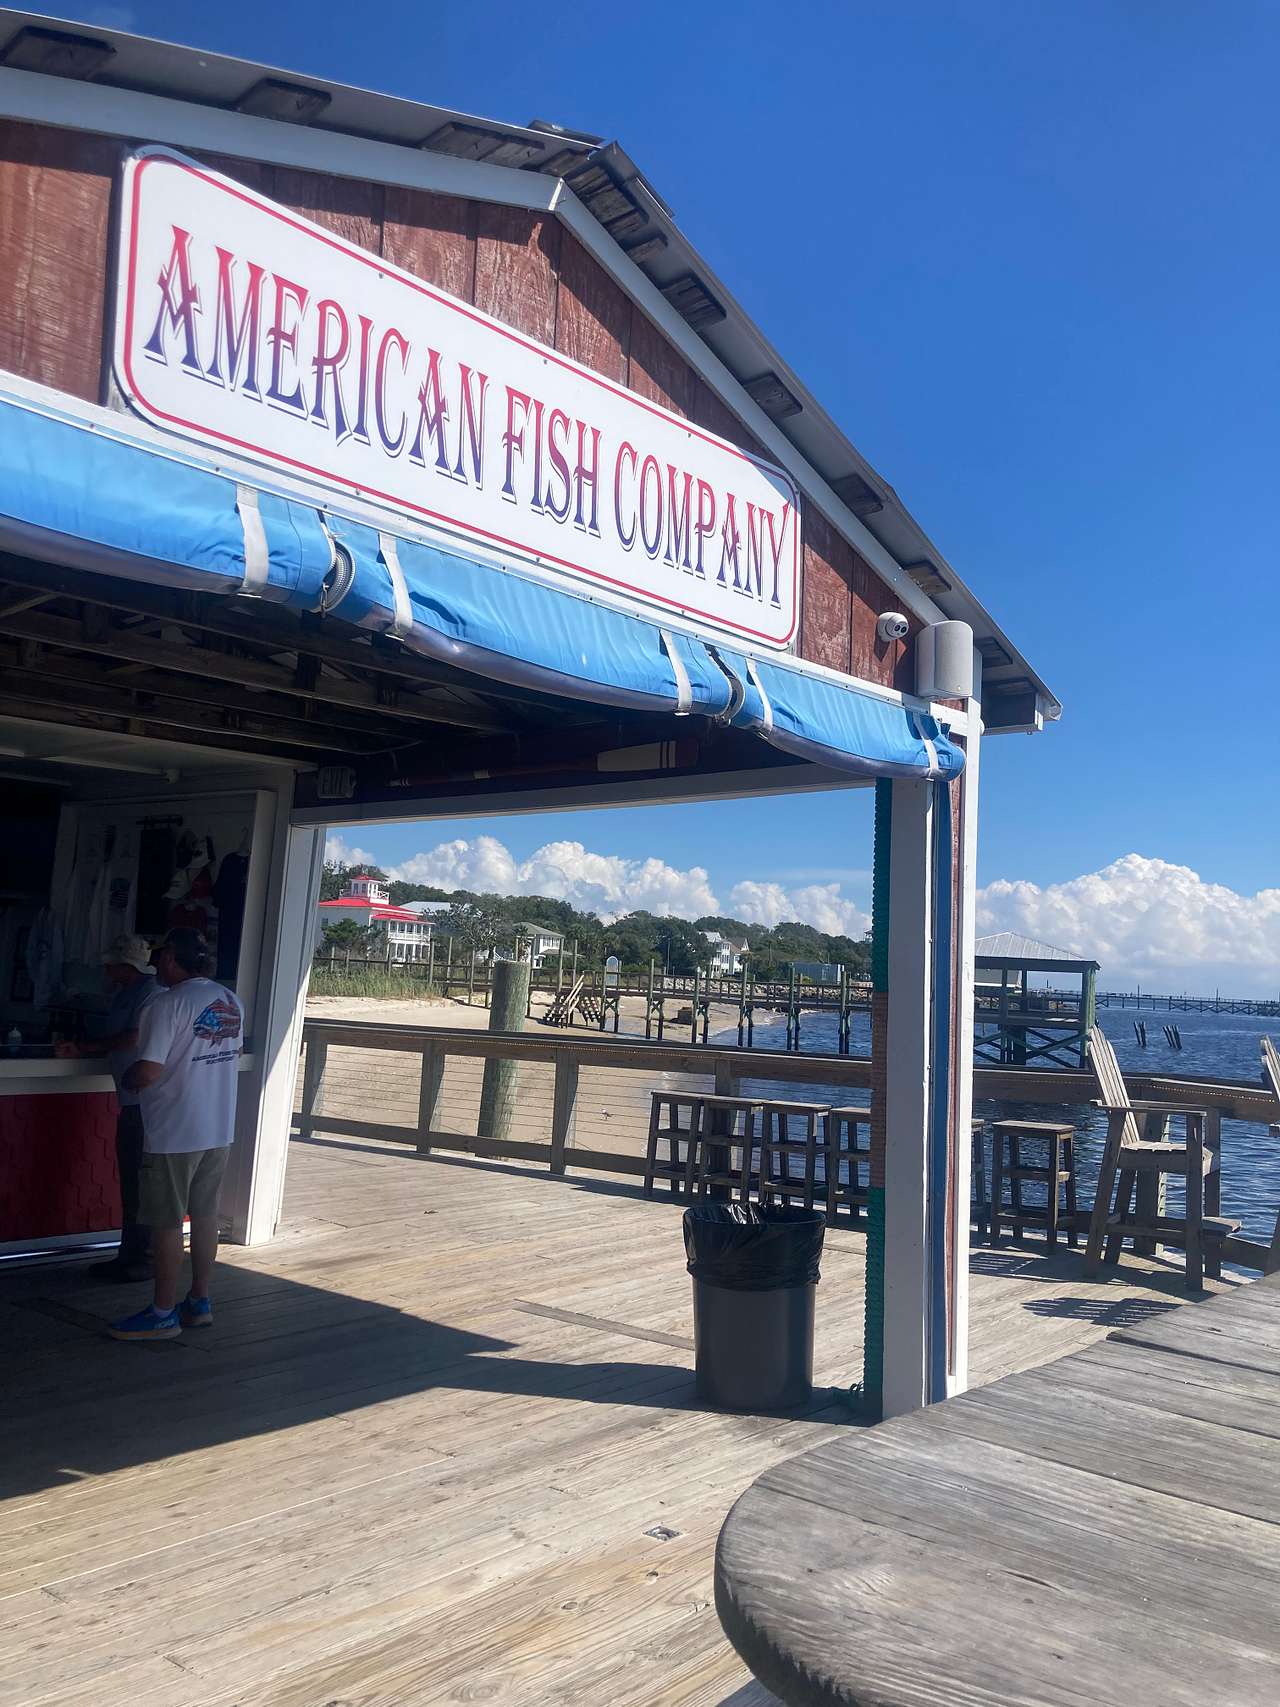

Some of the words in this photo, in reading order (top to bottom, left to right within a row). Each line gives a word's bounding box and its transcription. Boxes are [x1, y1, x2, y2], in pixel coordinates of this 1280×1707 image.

[143, 224, 490, 491] AMERICAN
[501, 385, 602, 538] FISH
[614, 441, 791, 609] COMPANY
